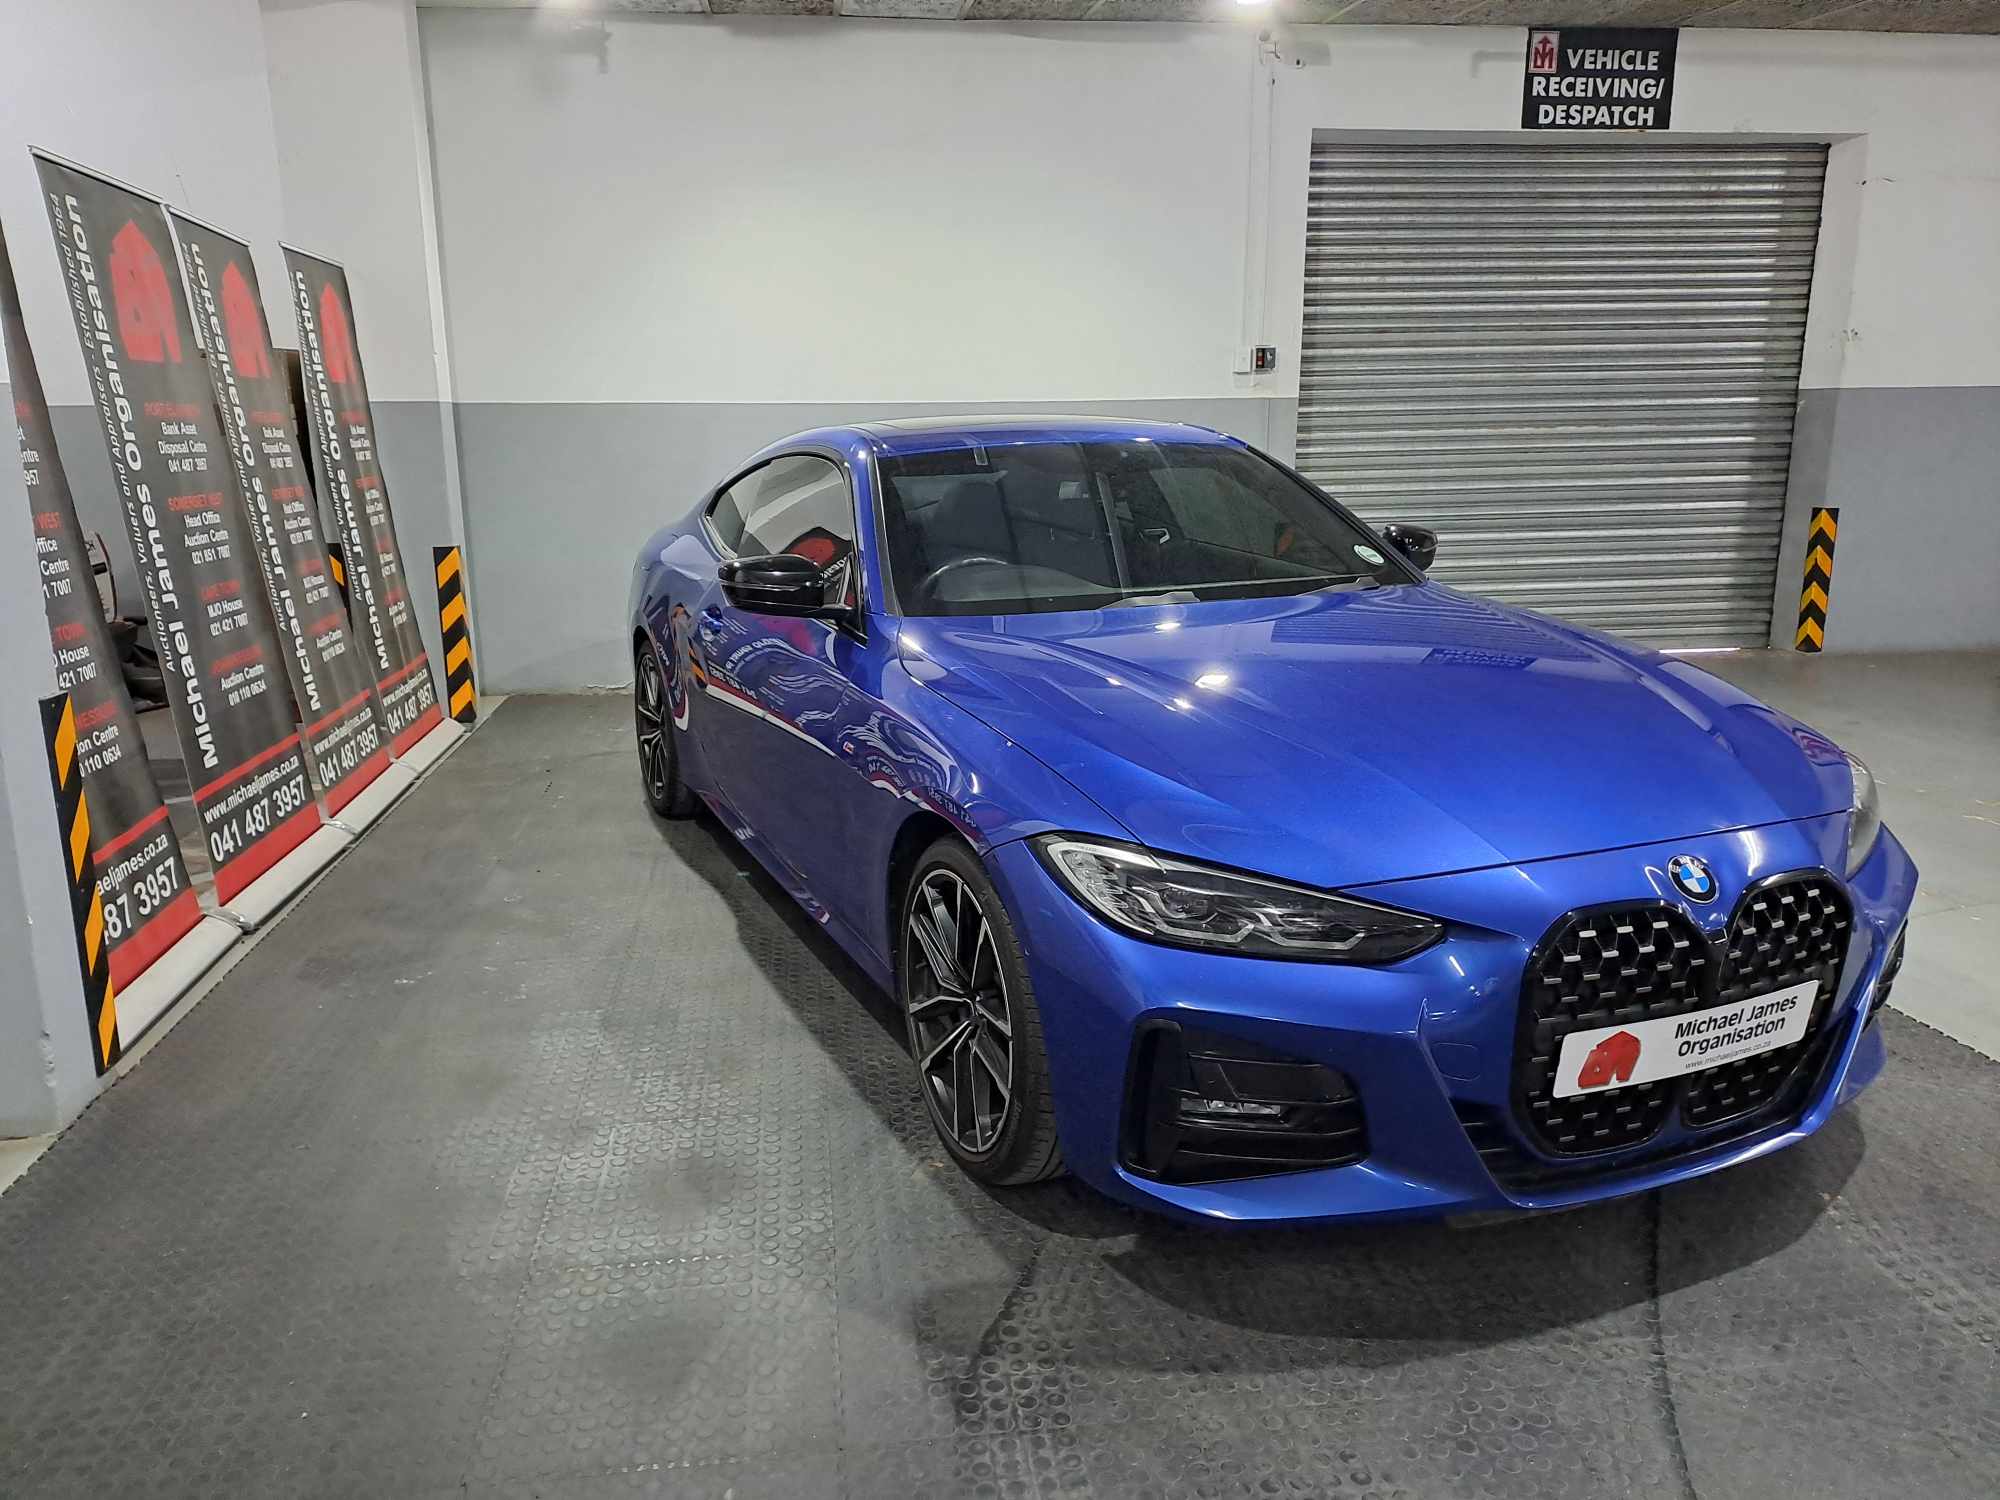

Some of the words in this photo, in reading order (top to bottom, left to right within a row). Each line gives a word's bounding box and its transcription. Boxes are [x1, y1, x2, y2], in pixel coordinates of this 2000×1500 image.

[1532, 77, 1665, 99] RECEIVING/
[1567, 49, 1660, 71] VEHICLE
[1538, 104, 1655, 126] DESPATCH
[60, 243, 95, 349] Established
[65, 194, 142, 471] Organisation
[191, 243, 255, 467] Organisation
[296, 271, 341, 461] Organisation
[93, 366, 122, 459] Appraisers
[21, 447, 40, 463] ntre
[23, 468, 40, 486] 957
[115, 462, 131, 497] and
[126, 502, 148, 564] Valuers
[252, 476, 287, 580] James
[337, 469, 363, 557] James
[36, 537, 58, 554] ffice
[40, 558, 70, 576] Centre
[136, 483, 179, 610] James
[50, 578, 72, 597] 7007
[357, 565, 390, 669] Michael
[58, 645, 90, 666] House
[58, 670, 77, 689] 421
[77, 662, 97, 682] 7007
[279, 589, 321, 712] Michael
[168, 621, 219, 769] Michael
[387, 706, 405, 734] 041
[404, 695, 418, 720] 487
[85, 754, 102, 774] 110
[102, 743, 122, 766] 0634
[92, 724, 119, 745] Centre
[319, 753, 342, 787] 041
[340, 739, 359, 770] 487
[357, 723, 379, 758] 3957
[203, 755, 300, 824] www.michaeljames.co.za
[210, 818, 242, 862] 041
[245, 797, 270, 837] 487
[273, 774, 306, 817] 3957
[97, 834, 168, 896] aeljames.co.za
[104, 893, 132, 945] 87
[133, 856, 178, 915] 3957
[1675, 1008, 1744, 1039] Michael
[1746, 995, 1798, 1022] James
[1678, 1017, 1786, 1057] Organisation
